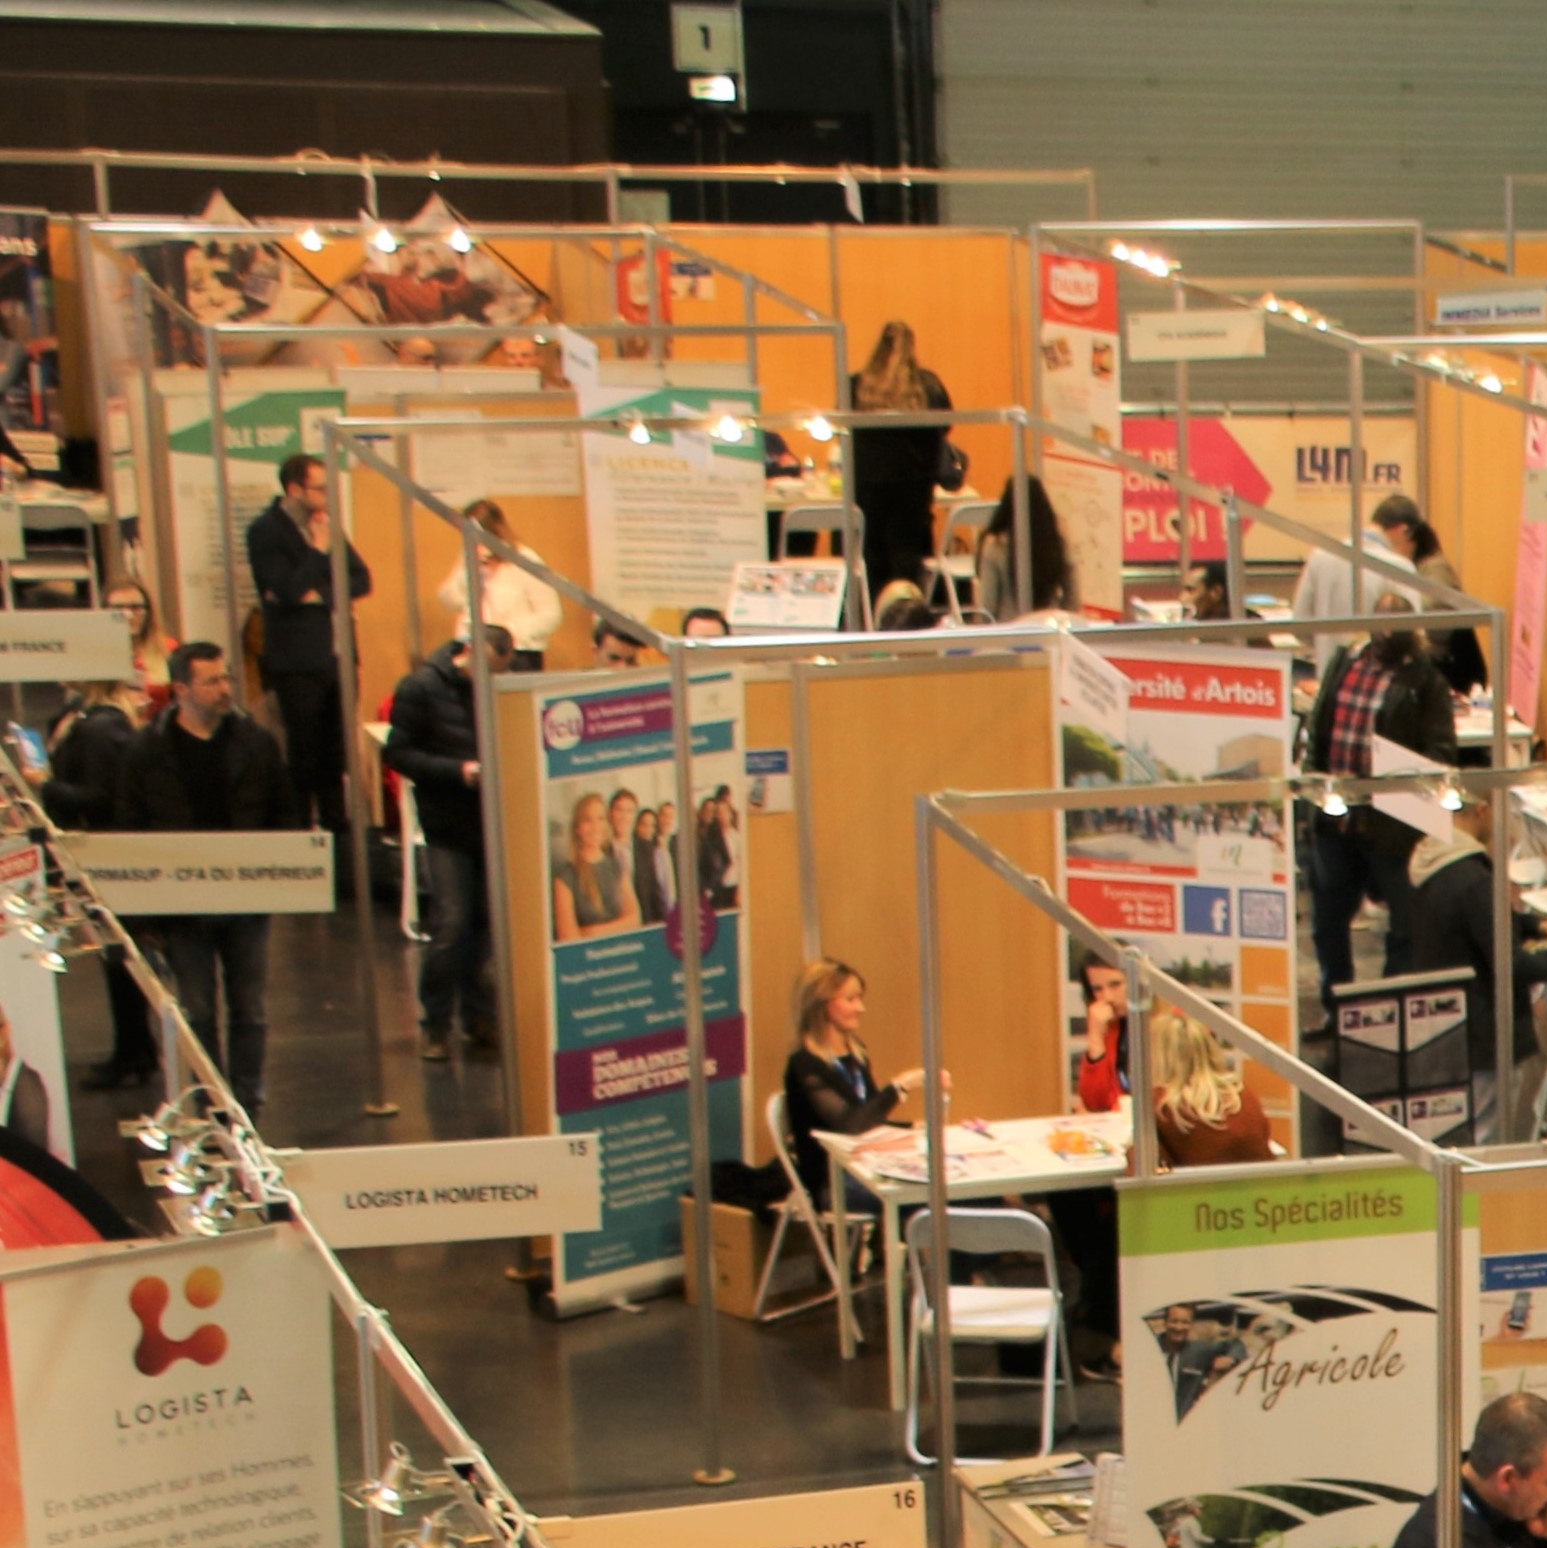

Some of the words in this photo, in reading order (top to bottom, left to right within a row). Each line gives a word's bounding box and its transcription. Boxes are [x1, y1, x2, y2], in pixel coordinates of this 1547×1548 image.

[84, 866, 161, 883] ORMASUP
[569, 1141, 588, 1157] 15
[344, 1188, 429, 1210] LOGISTA
[434, 1184, 539, 1205] HOMETECH
[1195, 1200, 1245, 1234] Nos
[1255, 1189, 1404, 1234] Spécialités
[1235, 1328, 1405, 1412] Agricole
[115, 1386, 254, 1430] LOGISTA
[894, 1488, 916, 1510] 16
